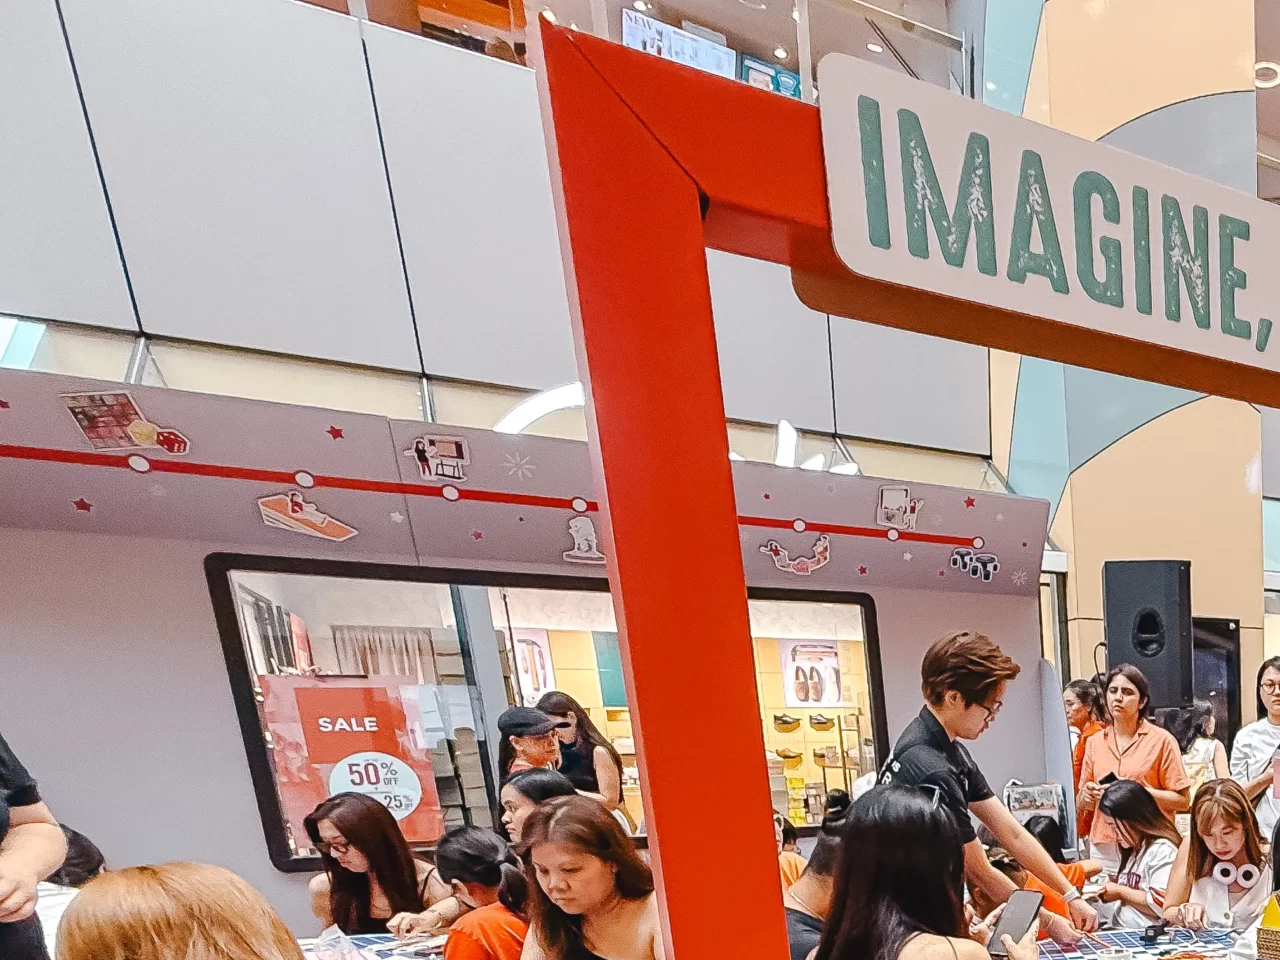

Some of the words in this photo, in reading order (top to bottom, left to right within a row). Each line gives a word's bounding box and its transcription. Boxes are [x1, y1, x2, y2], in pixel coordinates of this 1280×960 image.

[858, 95, 1272, 352] IMAGINE,
[318, 717, 379, 731] SALE
[347, 762, 398, 786] 50%
